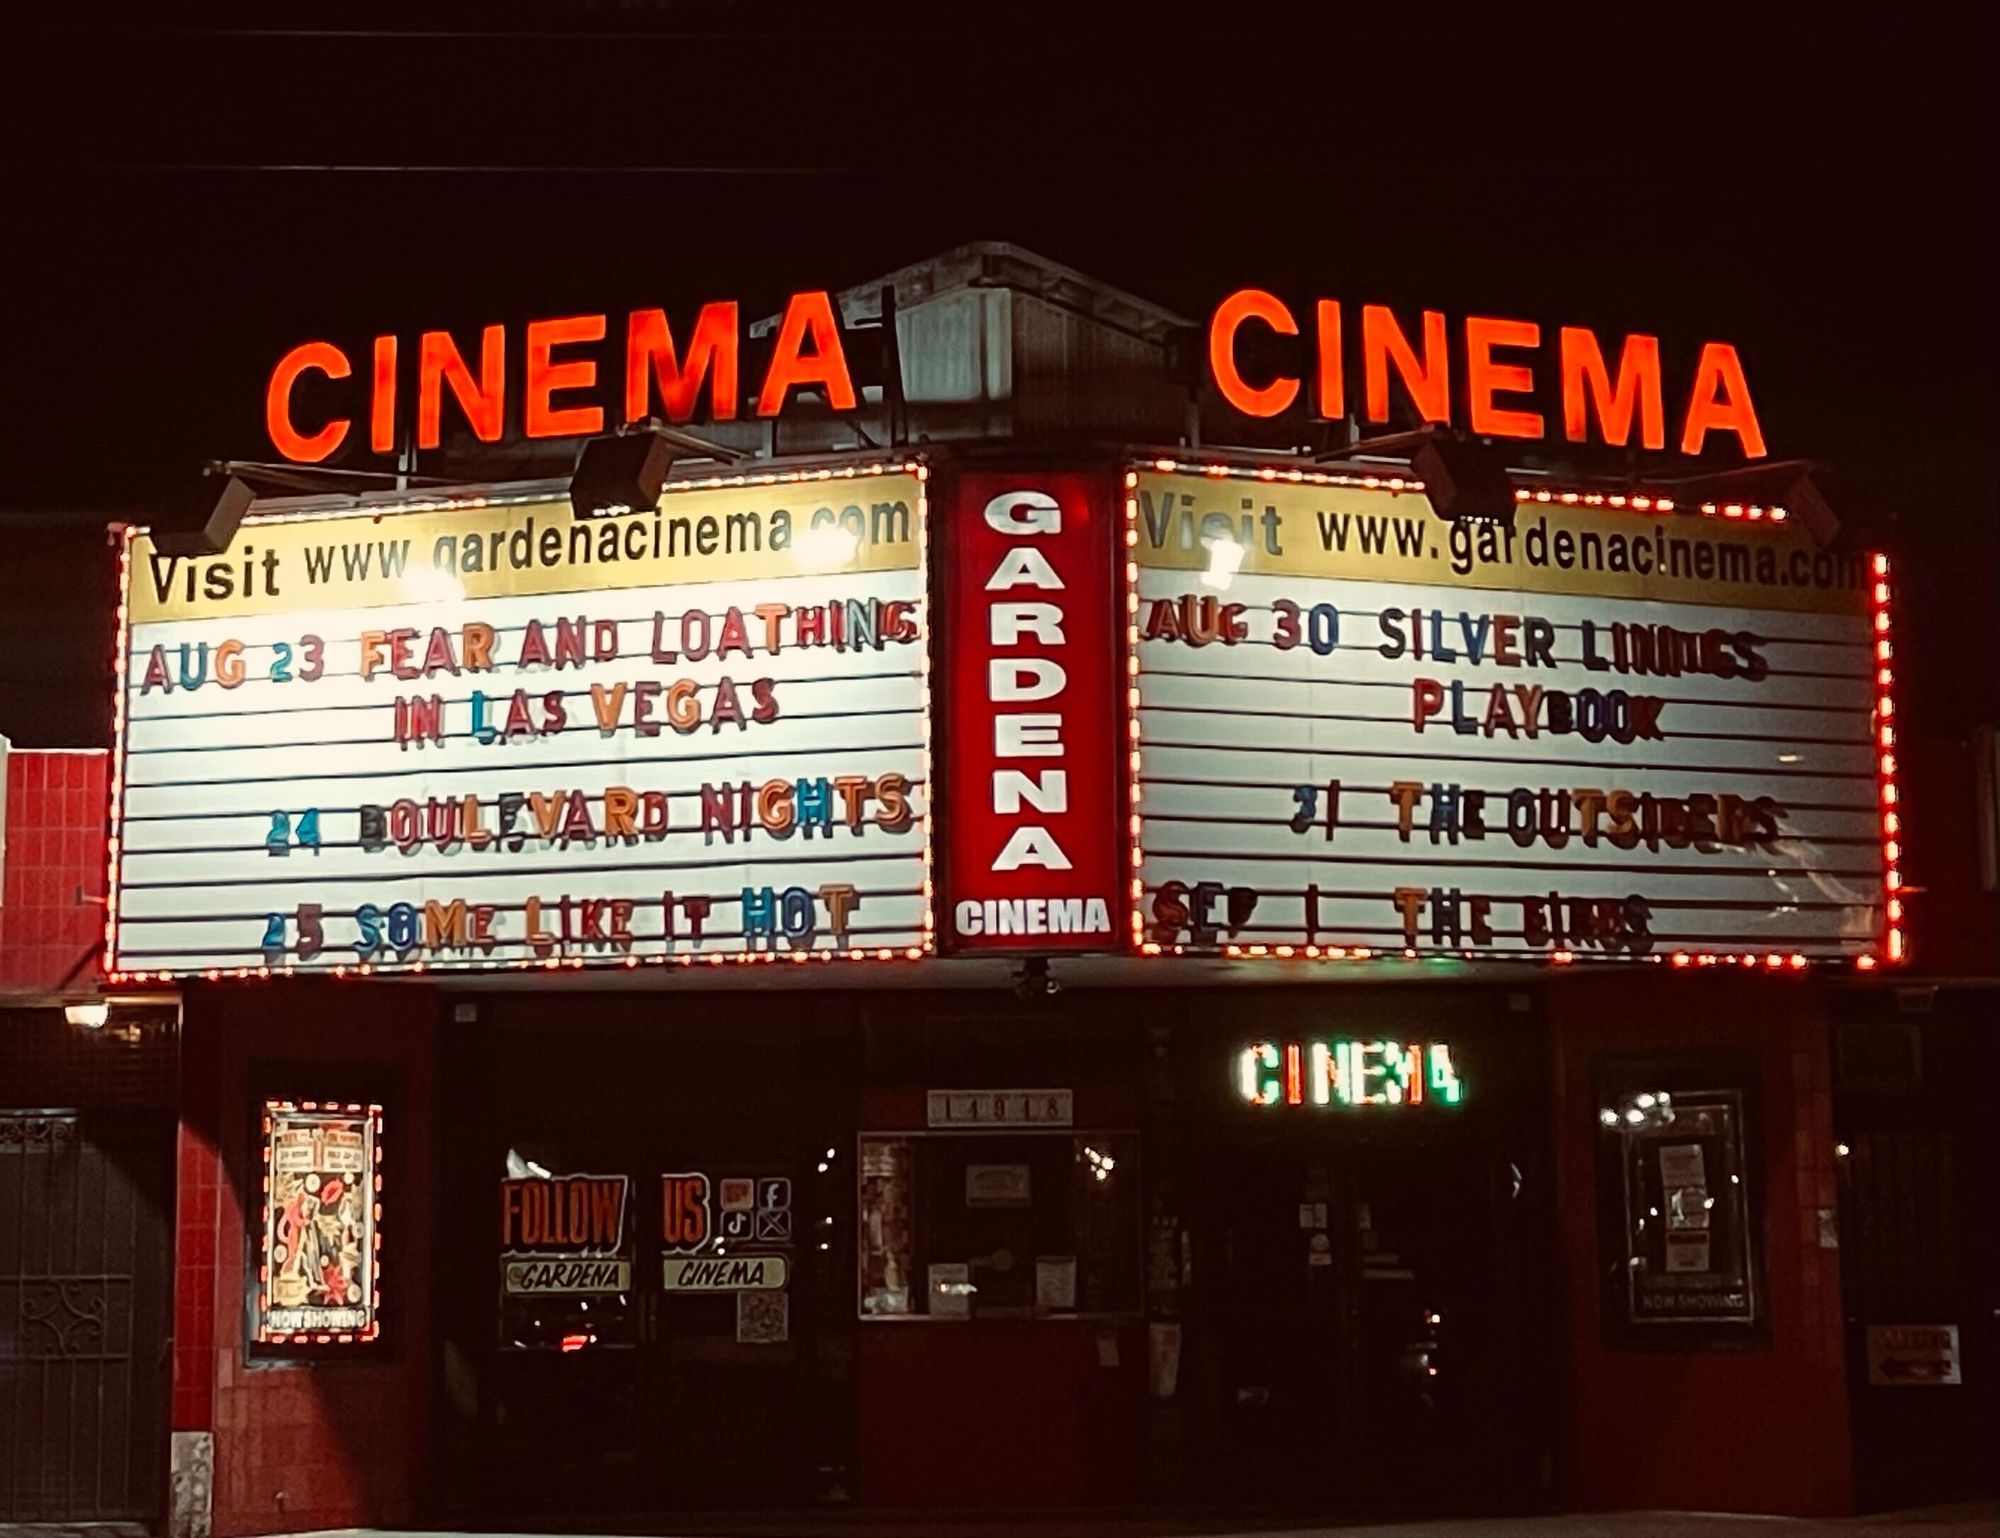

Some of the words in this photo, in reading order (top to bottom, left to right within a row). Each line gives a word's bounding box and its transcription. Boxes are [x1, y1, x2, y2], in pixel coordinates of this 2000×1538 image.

[267, 291, 857, 463] CINEMA
[1210, 289, 1767, 458] CINEMA
[1140, 490, 1283, 556] Visit
[150, 546, 280, 604] Visit
[140, 638, 247, 696] AUG
[270, 634, 326, 684] 23
[360, 621, 497, 682] FEAR
[519, 614, 619, 671] AND
[652, 596, 921, 665] LOATHING
[1141, 594, 1249, 648] AUG
[1272, 598, 1339, 656] 30
[1379, 607, 1557, 669] SILVER
[395, 692, 446, 749] IN
[472, 689, 568, 744] LAS
[590, 676, 779, 738] VEGAS
[984, 490, 1073, 871] GARDENA
[267, 807, 319, 857] 24
[360, 785, 669, 856] BOULEVARD
[701, 772, 914, 845] NIGHTS
[1289, 779, 1341, 842] 31
[1389, 781, 1486, 846] THE
[262, 903, 324, 964] 25
[354, 898, 499, 962] SOME
[525, 895, 634, 957] LIKE
[664, 891, 711, 951] IT
[742, 883, 861, 951] HOT
[955, 898, 1111, 936] CINEMA
[1393, 887, 1493, 948] THE
[1238, 1041, 1462, 1105] CINEMA
[503, 1180, 622, 1246] FOLLOW
[661, 1178, 706, 1243] US
[519, 1262, 620, 1289] GARDENA
[677, 1261, 765, 1287] CINEMA
[269, 1309, 303, 1329] NOW
[303, 1308, 367, 1329] SHOWING
